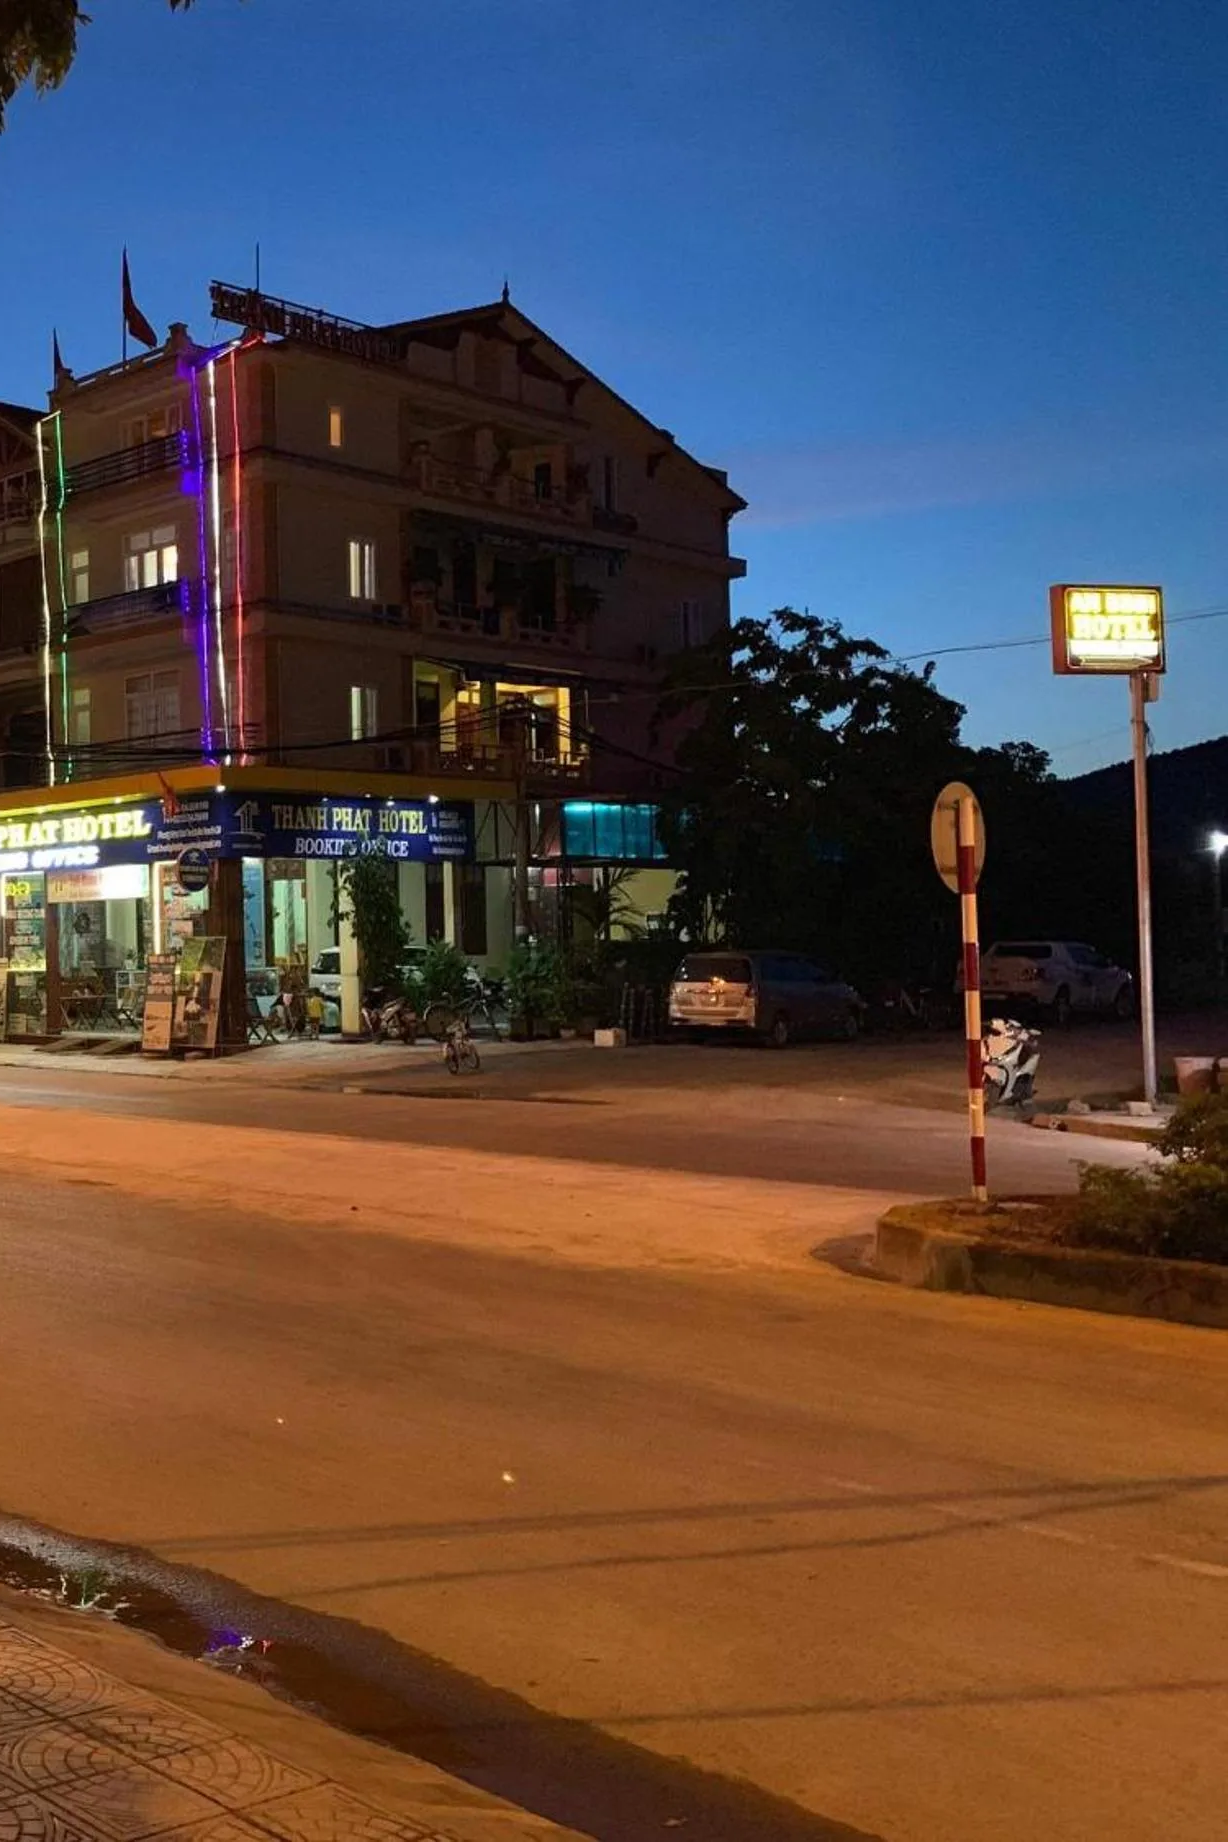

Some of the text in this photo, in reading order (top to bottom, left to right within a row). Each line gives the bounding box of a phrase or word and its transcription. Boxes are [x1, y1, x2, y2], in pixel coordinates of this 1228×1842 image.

[61, 811, 152, 841] HOTEL
[271, 804, 428, 834] THANH PHAT HOTEL
